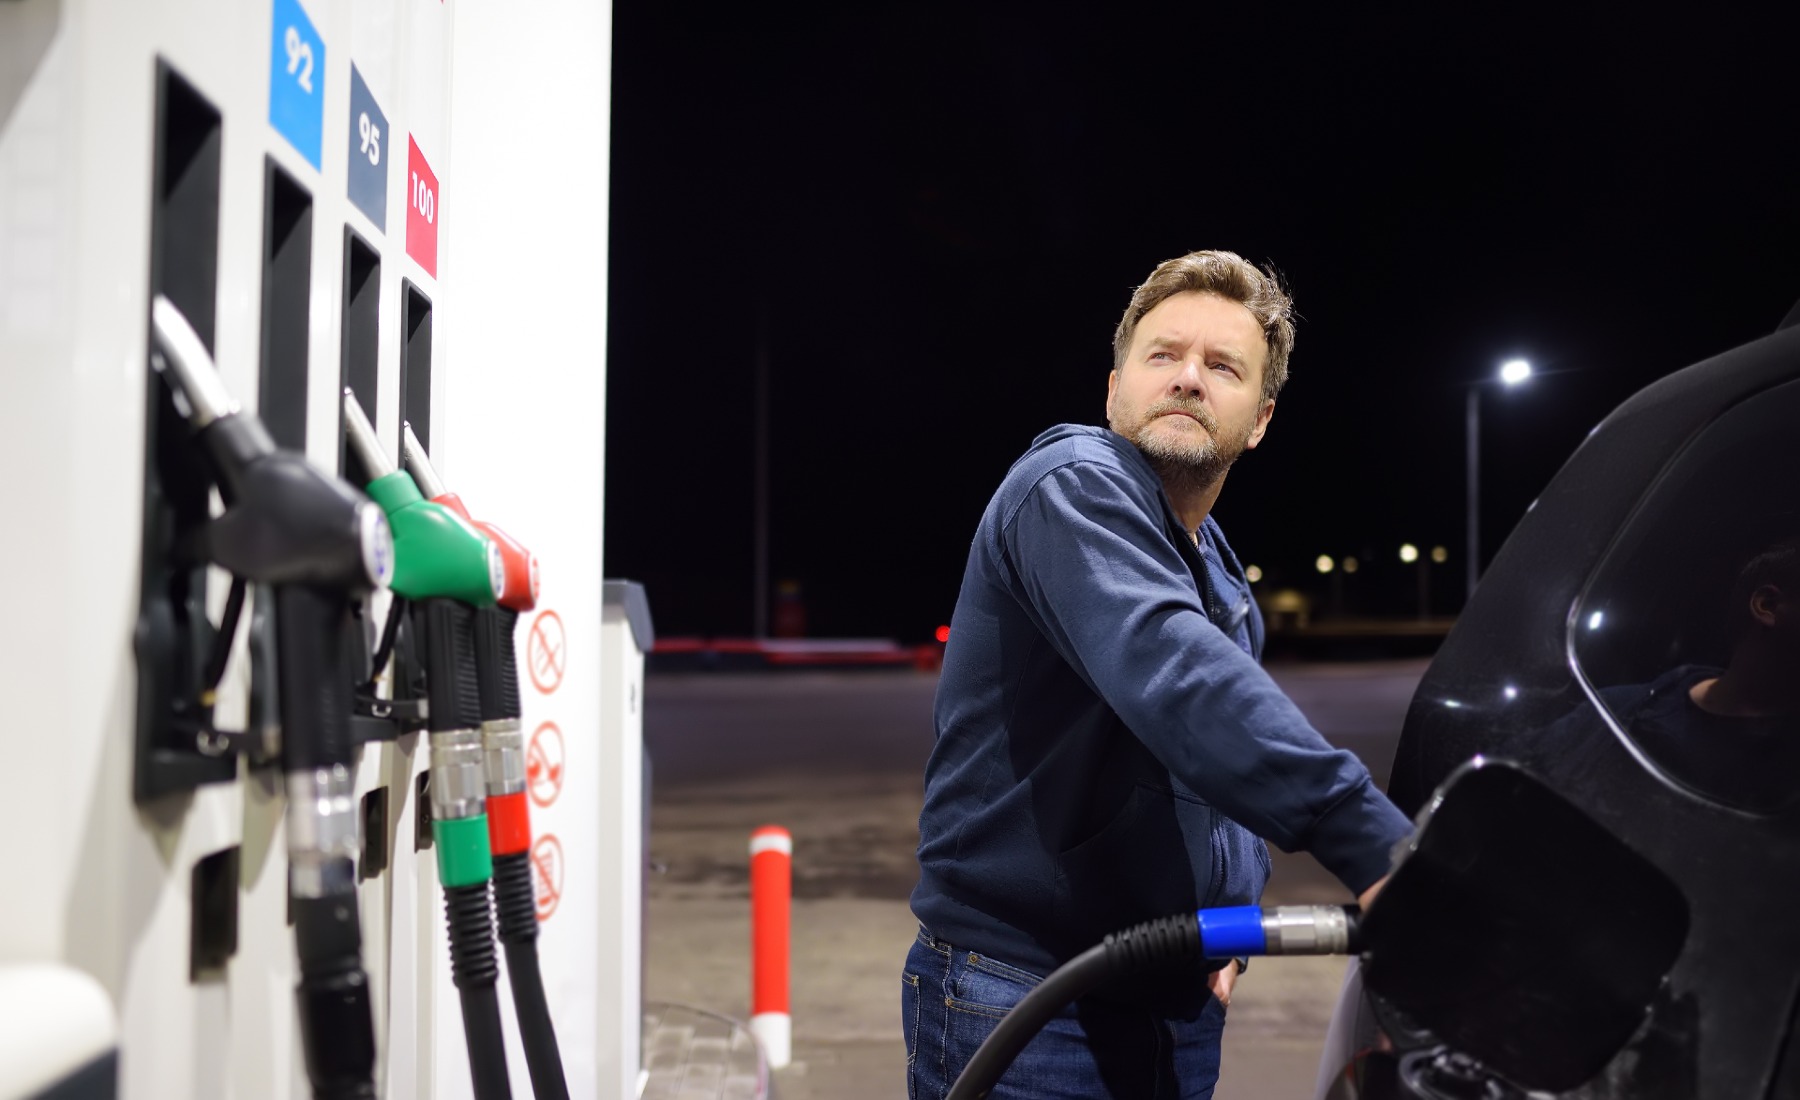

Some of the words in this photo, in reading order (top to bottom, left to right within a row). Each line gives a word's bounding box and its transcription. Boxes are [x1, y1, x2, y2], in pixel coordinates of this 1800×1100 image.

[285, 26, 313, 94] 92
[358, 112, 380, 166] 95
[412, 171, 434, 224] 100
